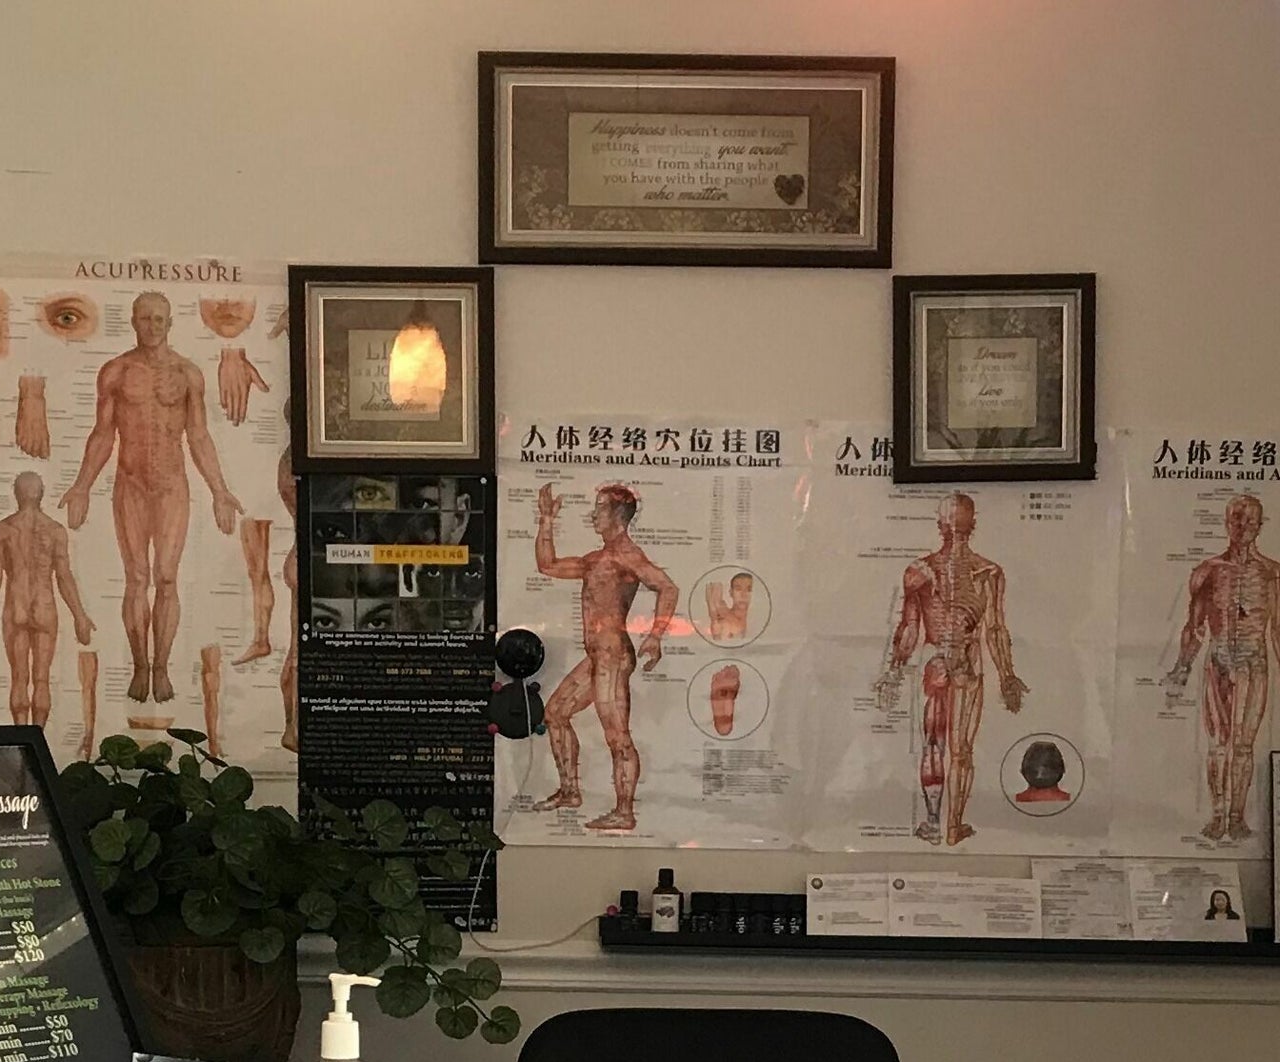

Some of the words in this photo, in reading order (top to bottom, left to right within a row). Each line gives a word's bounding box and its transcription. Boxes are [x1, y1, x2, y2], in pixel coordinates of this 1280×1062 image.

[590, 119, 667, 142] Happiness
[669, 126, 719, 138] doesn't
[722, 128, 758, 138] come
[760, 126, 794, 139] from
[591, 141, 639, 155] getting
[718, 144, 746, 159] you
[657, 158, 690, 169] from
[694, 159, 744, 173] sharing
[747, 159, 779, 171] what
[603, 173, 627, 186] you
[631, 171, 664, 185] have
[666, 172, 695, 185] with
[700, 172, 721, 185] the
[724, 174, 768, 187] people
[643, 185, 675, 201] who
[75, 261, 243, 283] ACUPRESSURE
[521, 424, 780, 454] 人体经络穴位挂图
[520, 450, 601, 465] Meridians
[605, 453, 635, 466] and
[639, 453, 731, 468] Acu-points
[736, 455, 782, 468] Chart
[1152, 466, 1231, 480] Meridians
[1237, 467, 1265, 481] and
[331, 549, 370, 558] HUMAN
[380, 549, 464, 560] TRAFFICKING
[12, 879, 32, 890] Hot
[32, 877, 61, 887] Stone
[11, 920, 35, 935] $50
[17, 935, 40, 949] $80
[15, 949, 45, 964] $120
[7, 975, 49, 988] Massage
[26, 986, 68, 999] Massage
[42, 996, 99, 1012] Reflexology
[45, 1014, 69, 1029] $50
[50, 1029, 73, 1044] $70
[48, 1043, 79, 1059] $110
